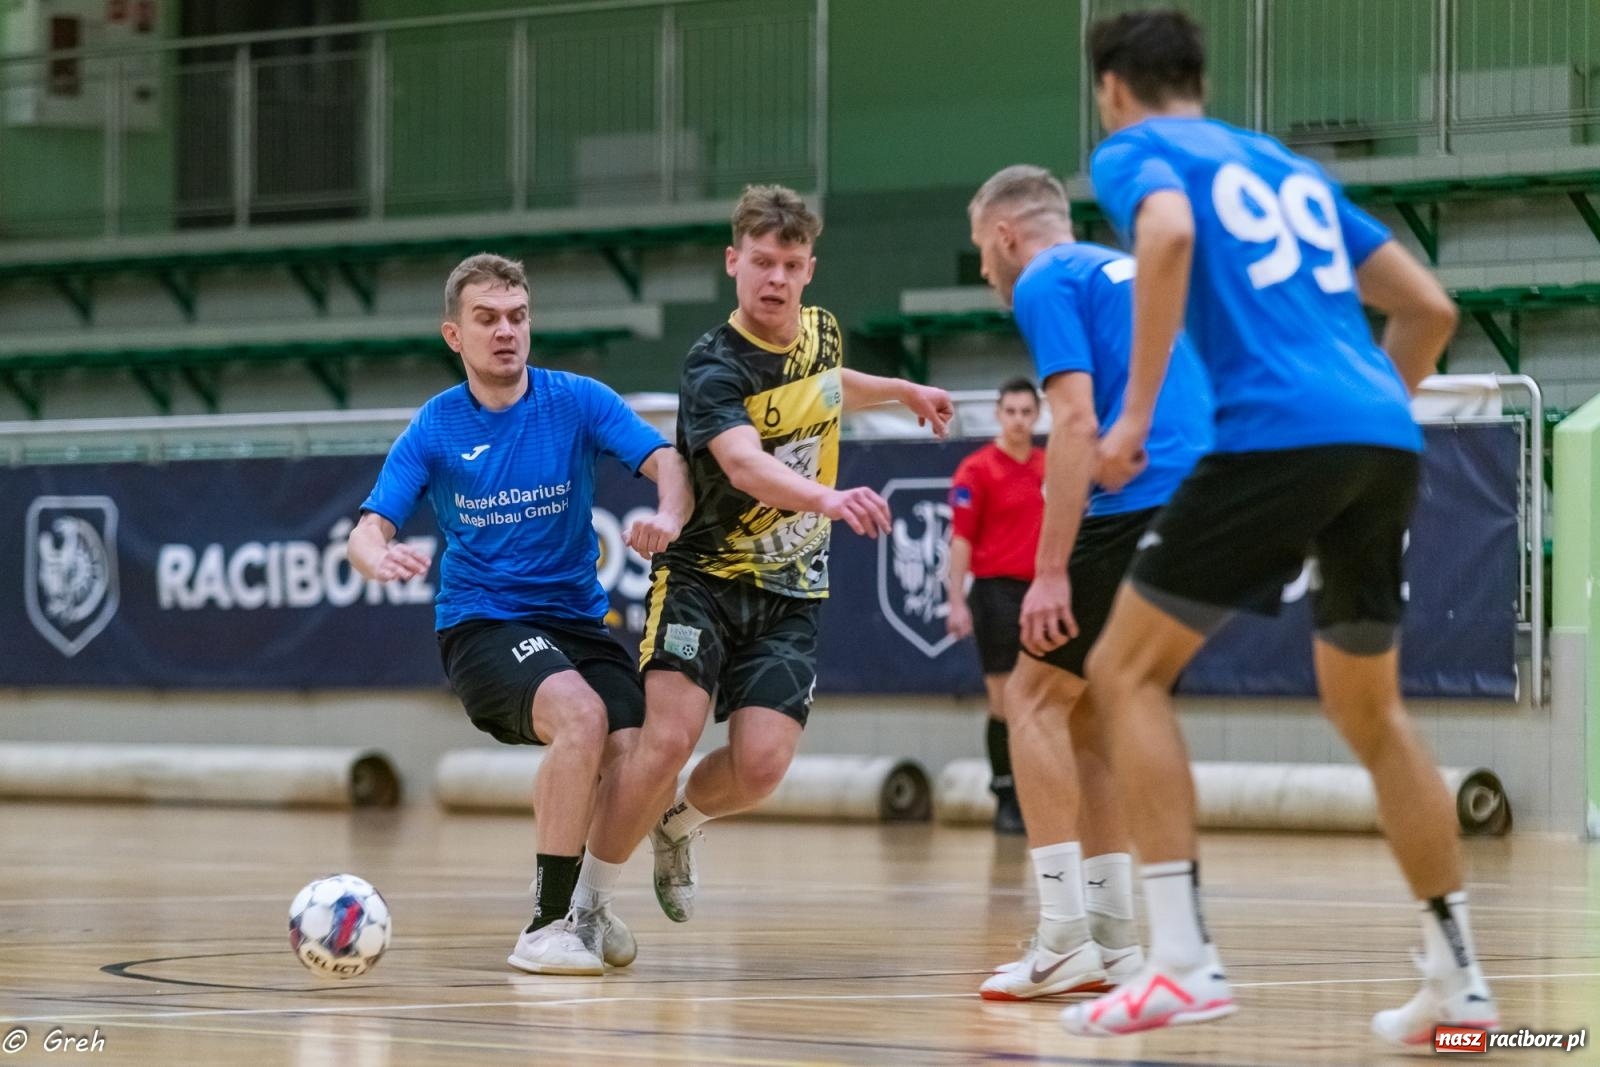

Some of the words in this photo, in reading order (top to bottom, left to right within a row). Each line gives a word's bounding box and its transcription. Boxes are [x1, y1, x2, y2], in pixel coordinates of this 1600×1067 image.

[1212, 163, 1353, 294] 99
[454, 480, 572, 510] Marek&Dariusz
[459, 511, 522, 528] Meallbau
[524, 498, 569, 519] GmbH
[511, 636, 563, 663] LSM
[305, 949, 361, 974] SELECT
